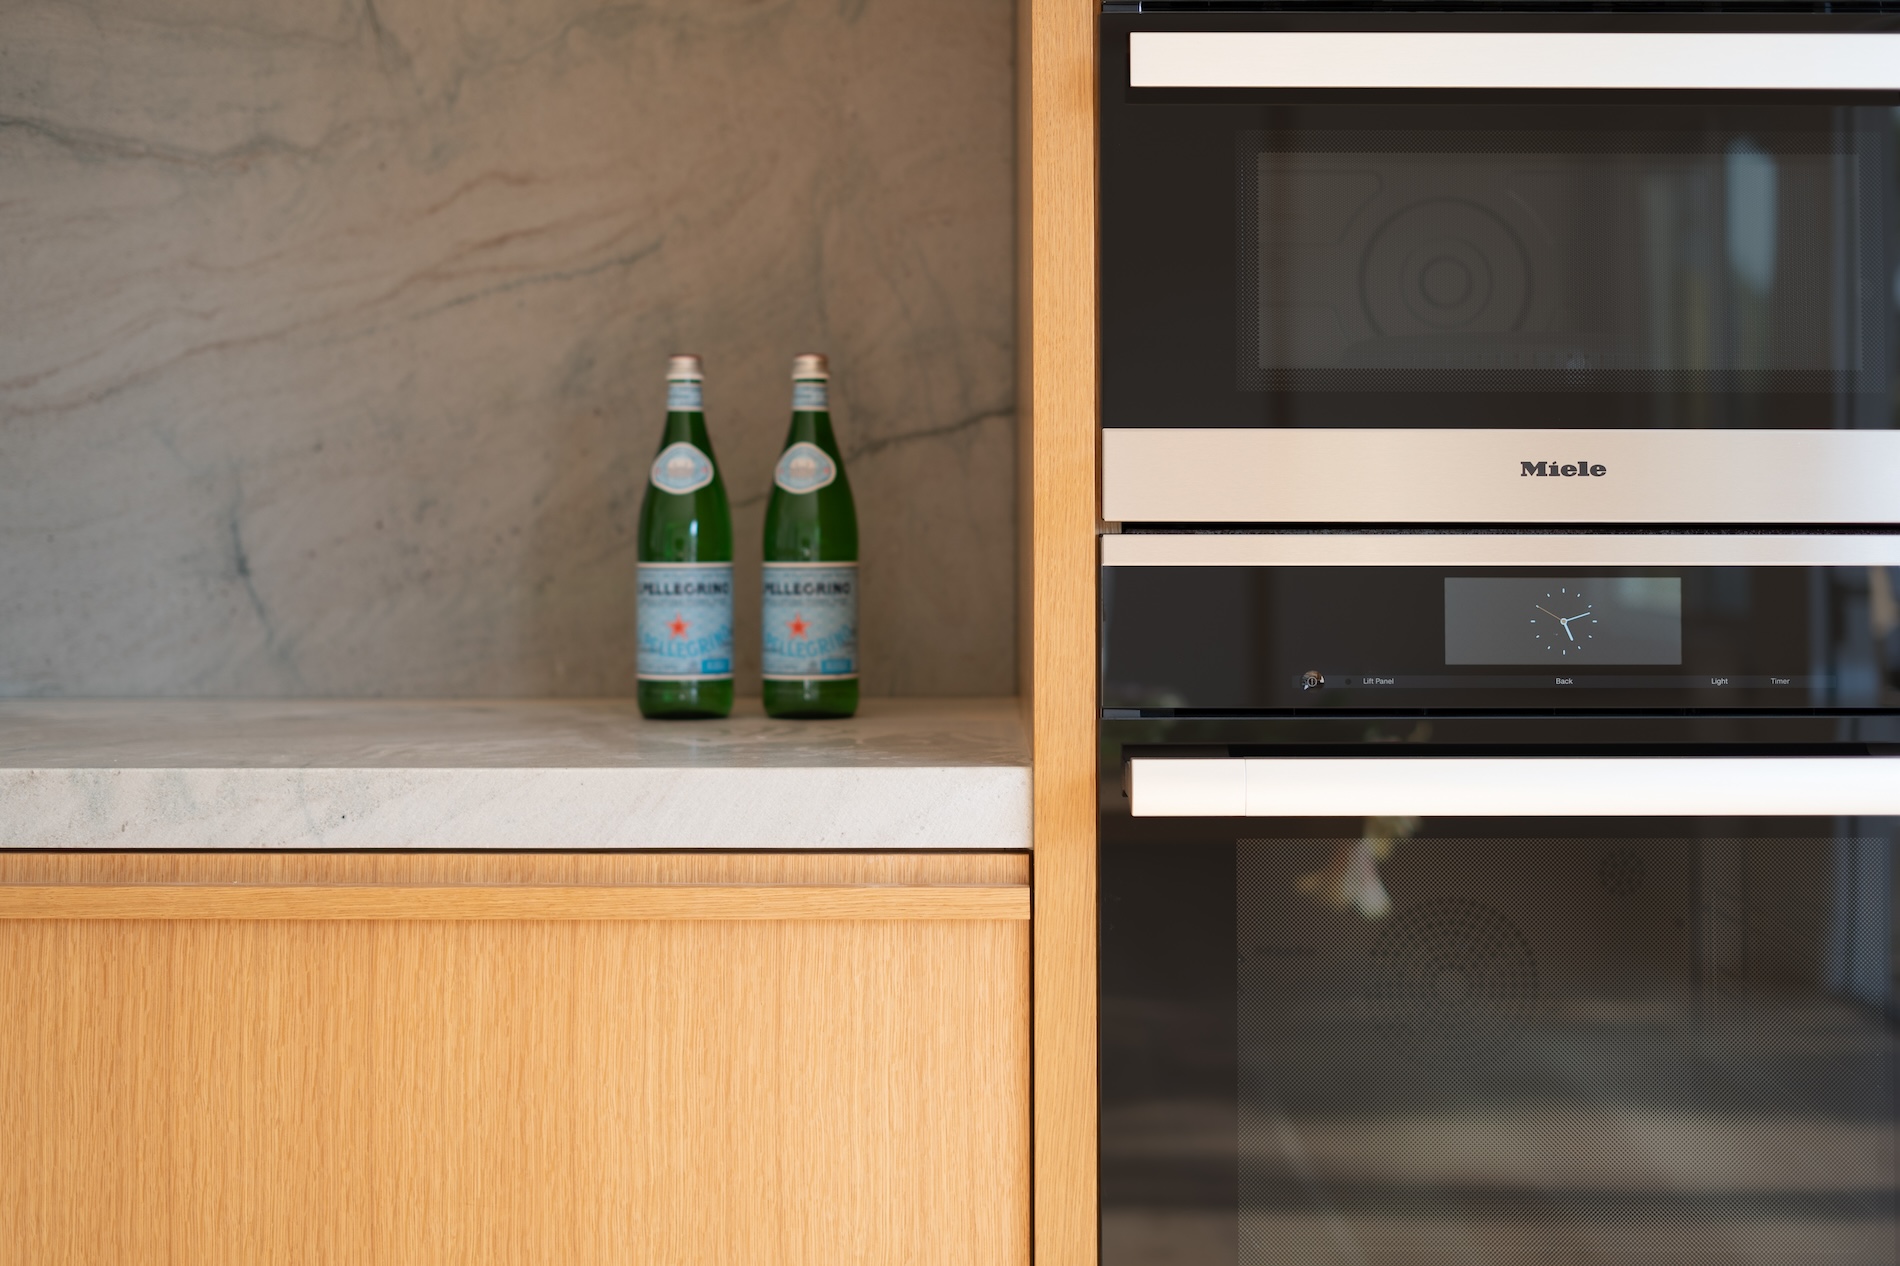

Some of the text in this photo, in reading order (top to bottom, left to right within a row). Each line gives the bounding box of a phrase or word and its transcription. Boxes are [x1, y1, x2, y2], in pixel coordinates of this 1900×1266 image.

[1520, 461, 1607, 477] Miele
[1362, 677, 1395, 685] Lift Panel
[1555, 677, 1574, 685] Back
[1710, 677, 1729, 687] Light
[1770, 677, 1791, 685] Timer
